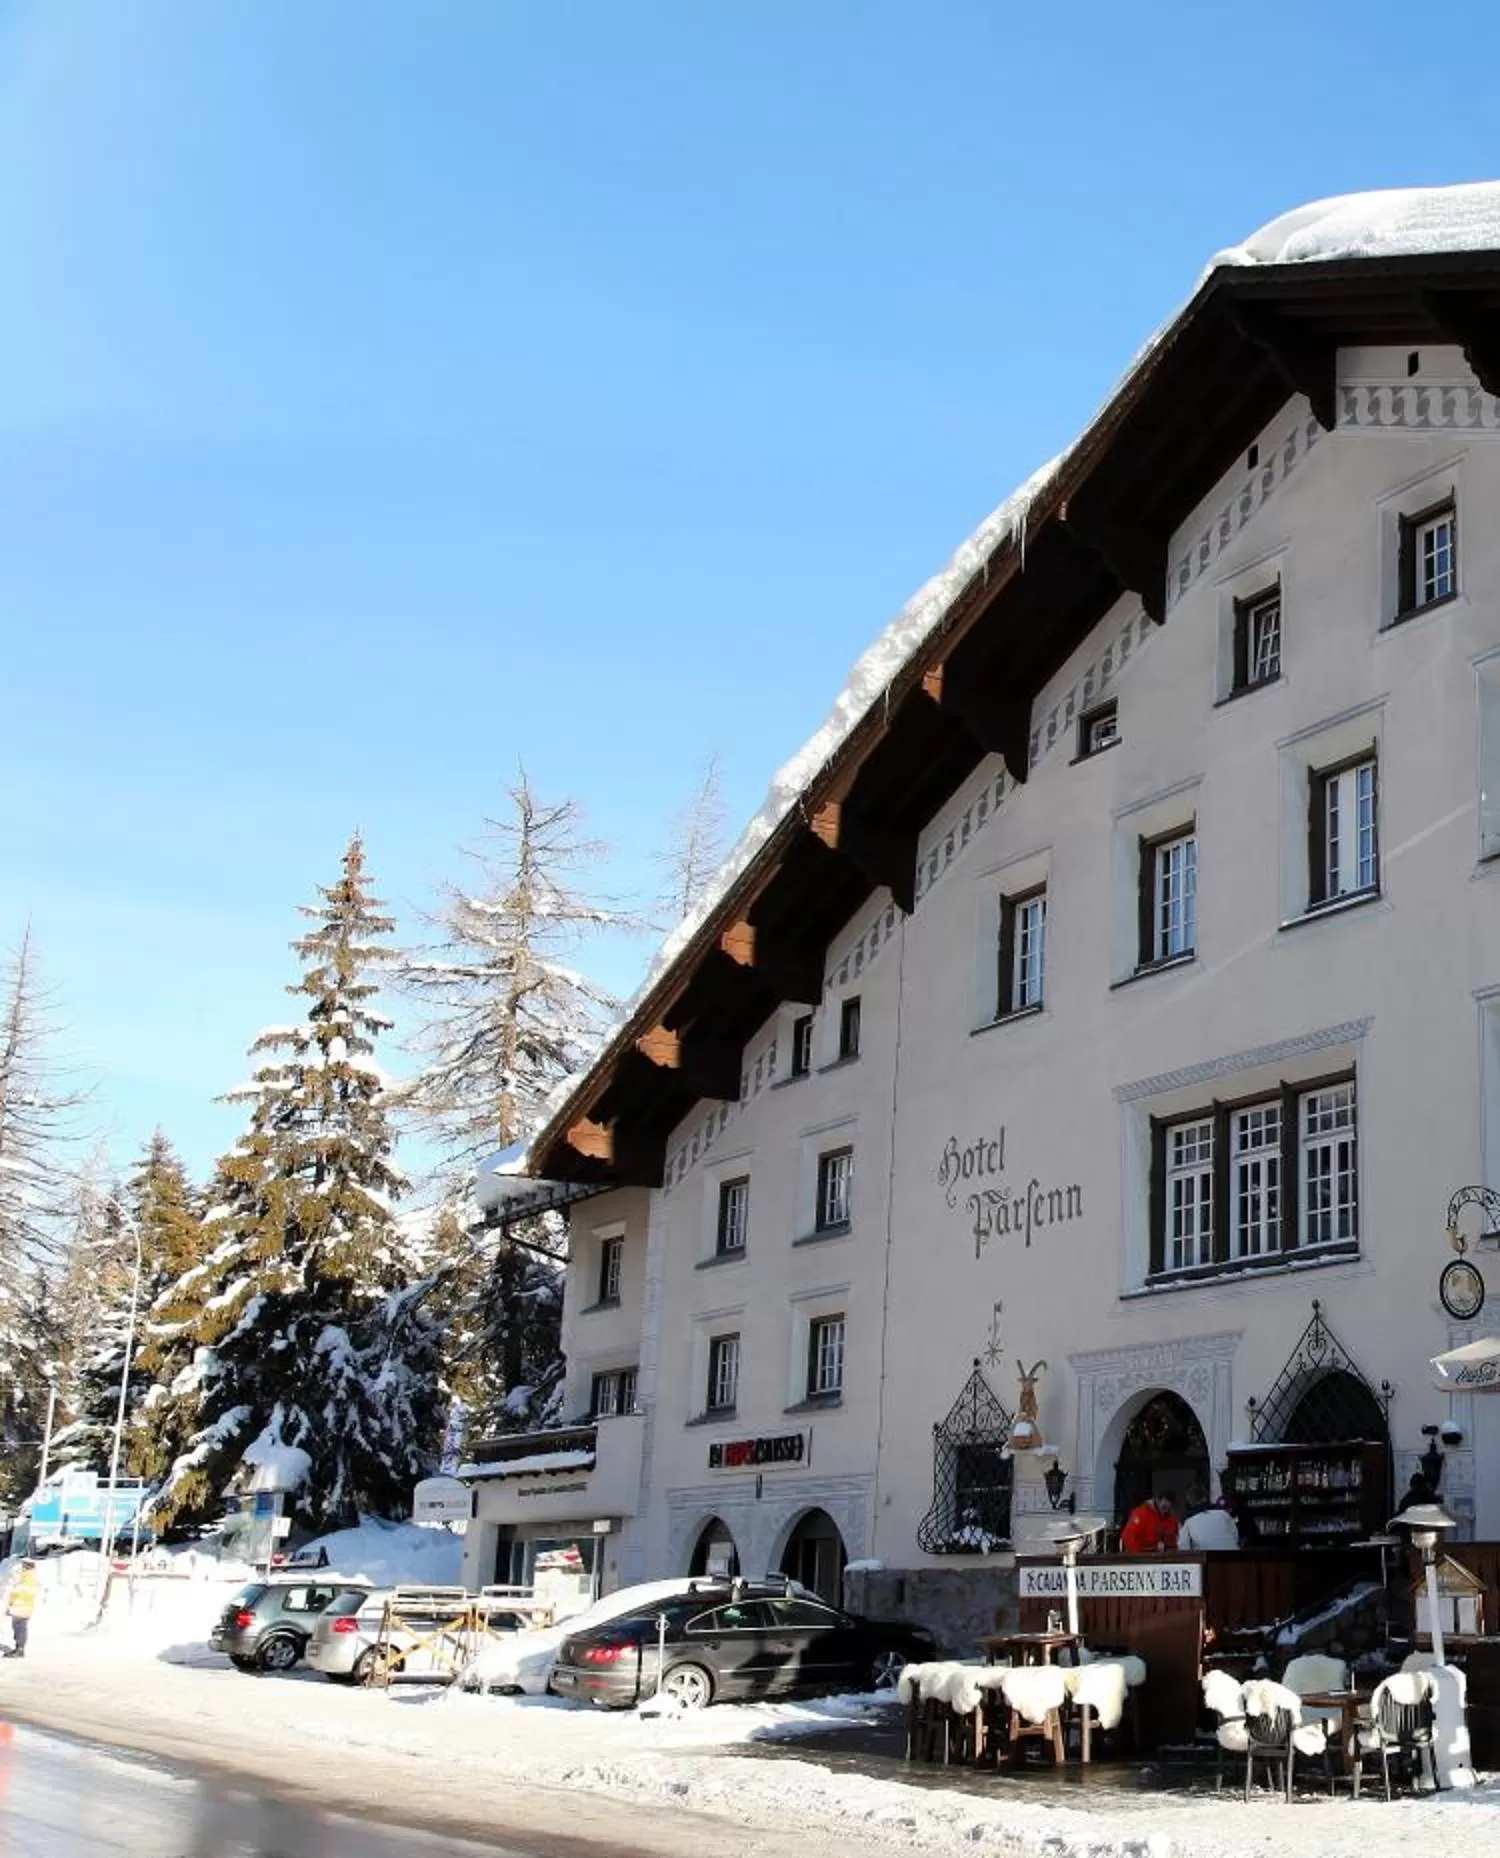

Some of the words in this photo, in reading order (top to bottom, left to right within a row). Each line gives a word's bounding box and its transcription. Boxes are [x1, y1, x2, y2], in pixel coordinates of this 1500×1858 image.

[938, 1125, 1005, 1208] Hotel
[1091, 1570, 1155, 1591] PARSENN
[1160, 1569, 1191, 1591] BAR
